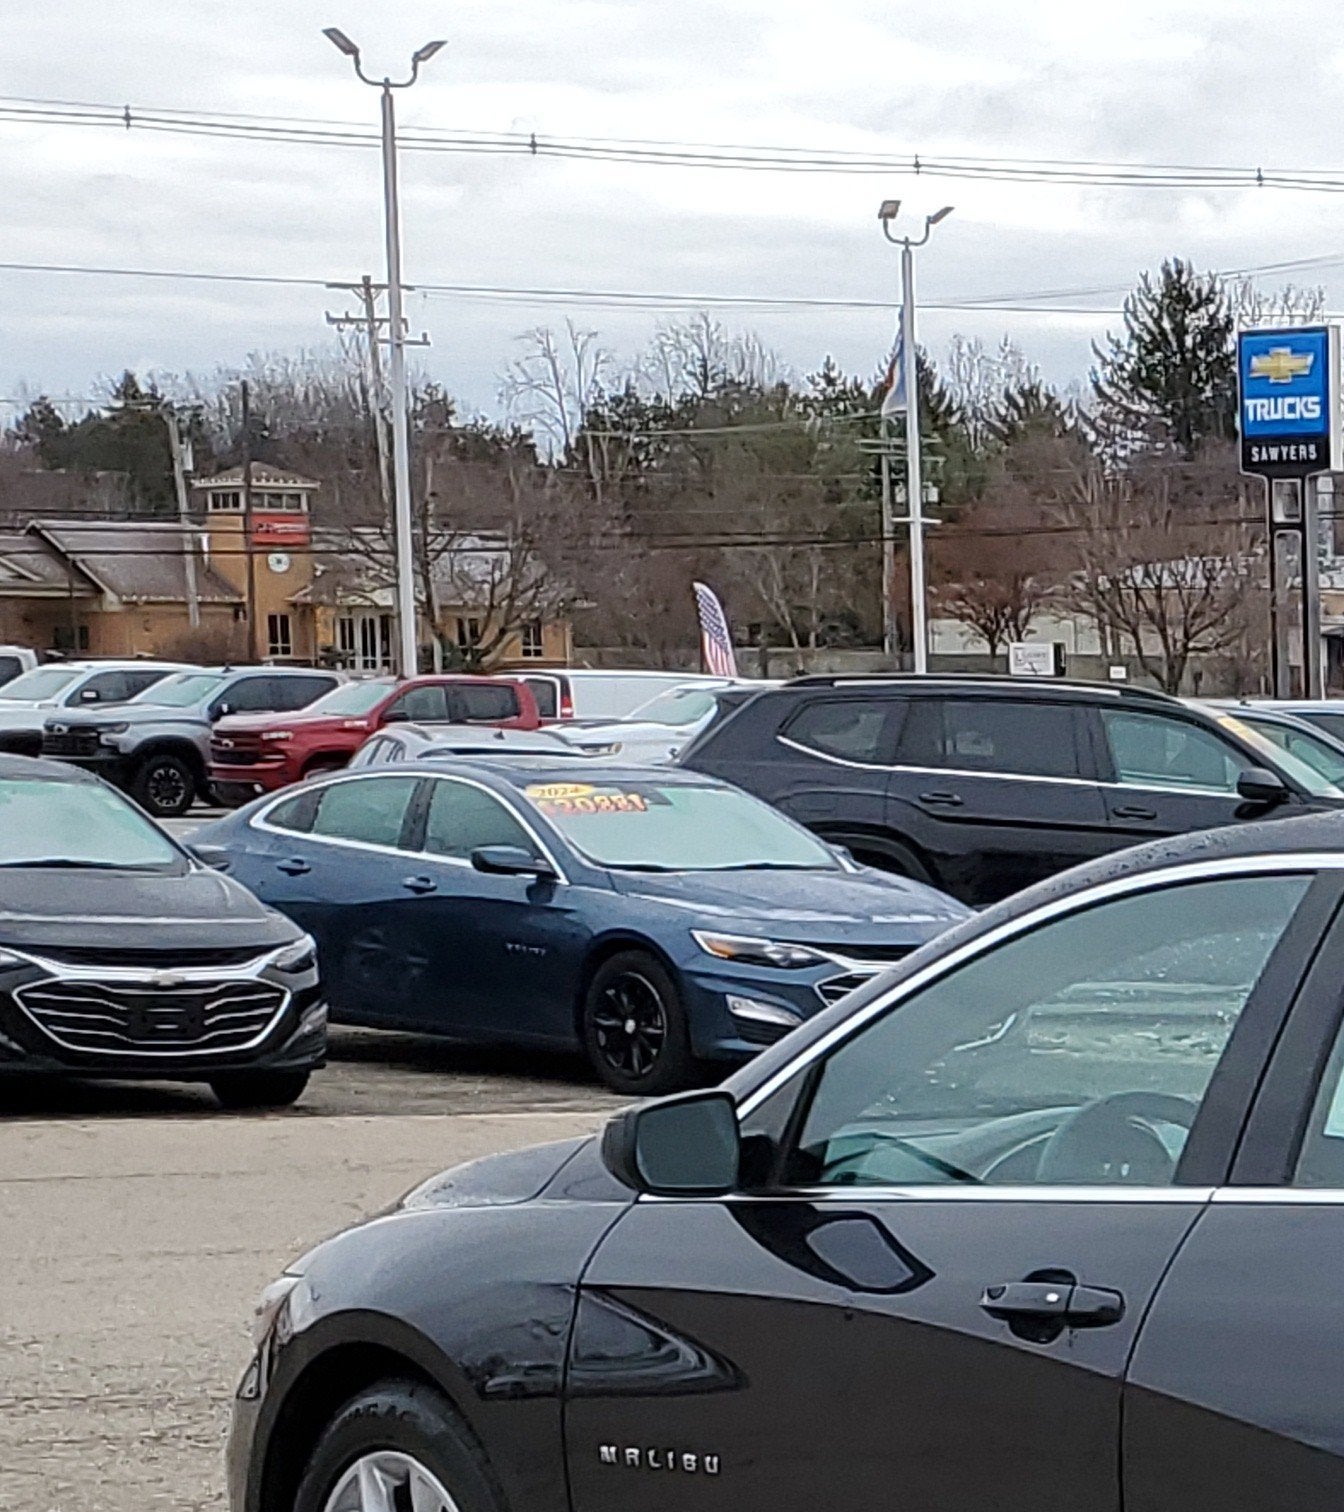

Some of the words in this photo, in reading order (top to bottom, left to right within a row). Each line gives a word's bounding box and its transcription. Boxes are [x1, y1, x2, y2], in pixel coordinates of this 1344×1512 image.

[1244, 396, 1321, 422] TRUCKS
[1251, 444, 1318, 463] SAWYERS
[599, 1445, 719, 1474] MALIBU
